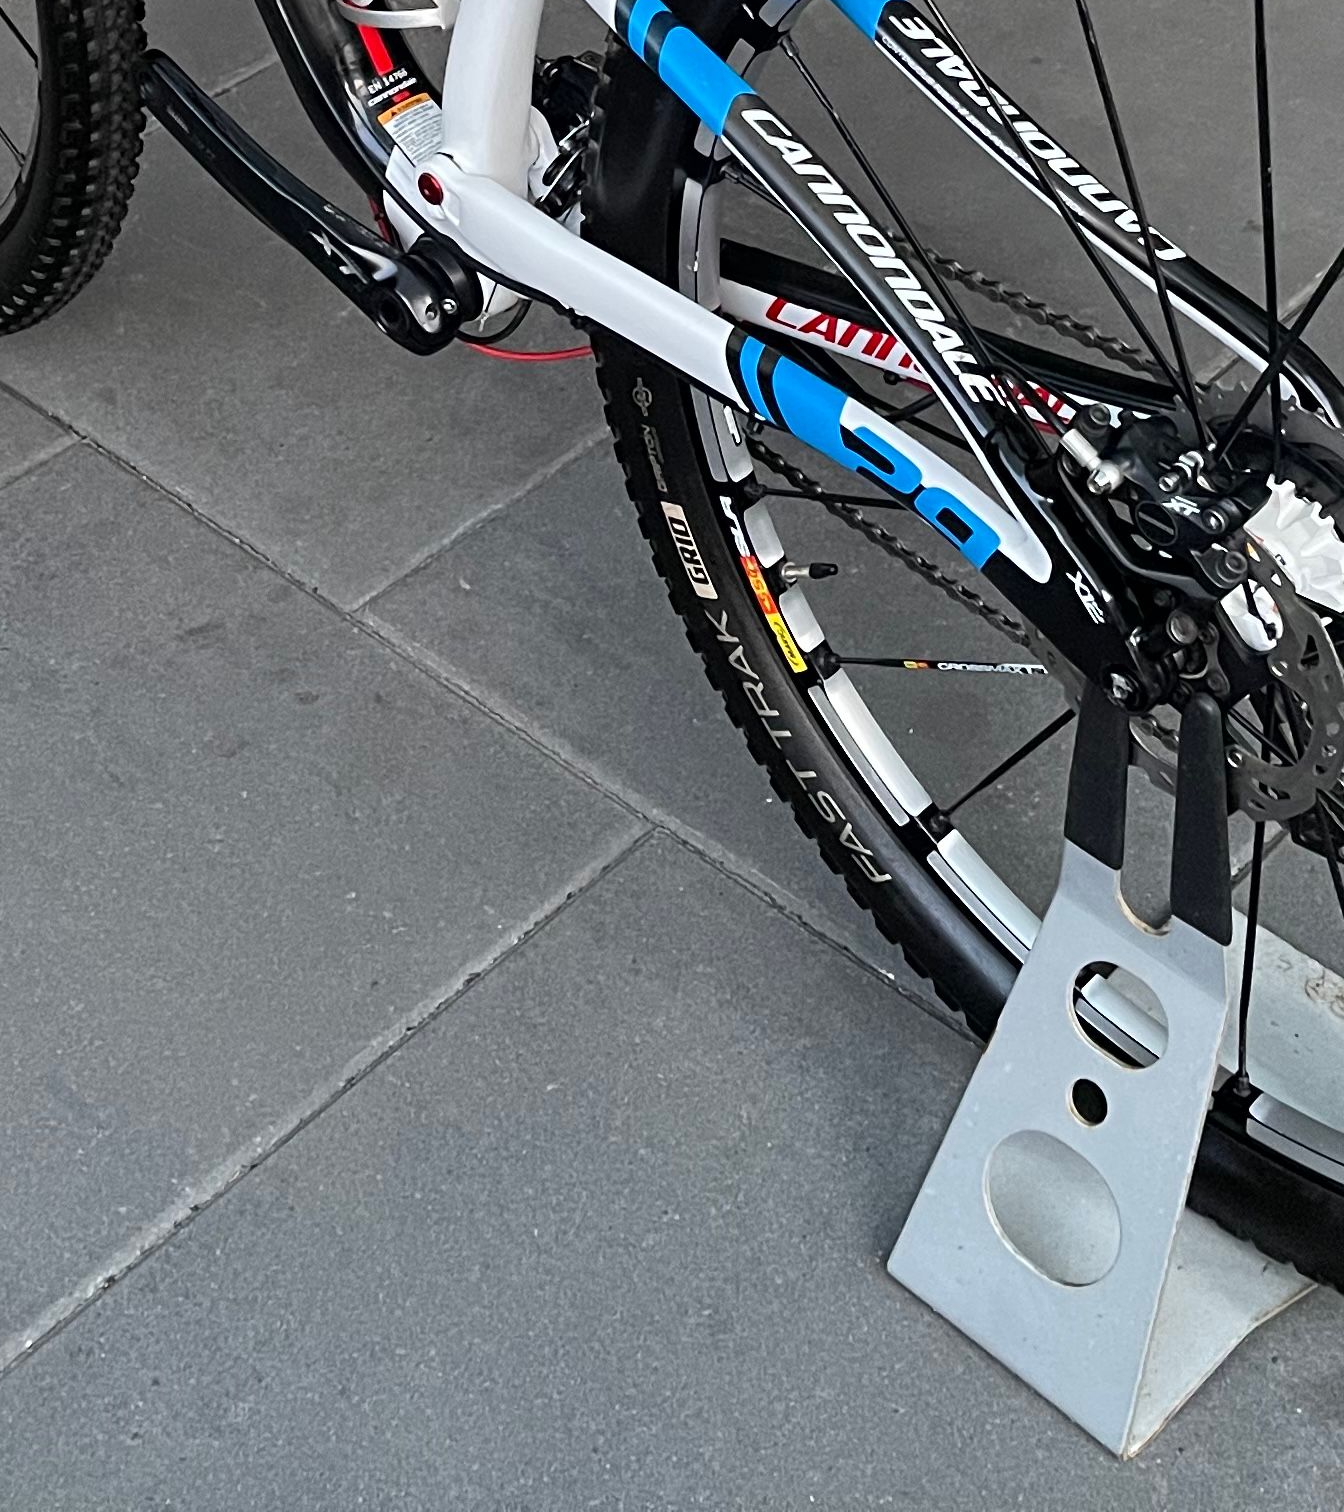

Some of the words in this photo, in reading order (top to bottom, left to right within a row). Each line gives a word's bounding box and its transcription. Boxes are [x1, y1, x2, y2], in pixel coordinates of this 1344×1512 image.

[668, 516, 711, 586] GRID
[704, 609, 793, 750] TRAK
[786, 759, 893, 884] FAST
